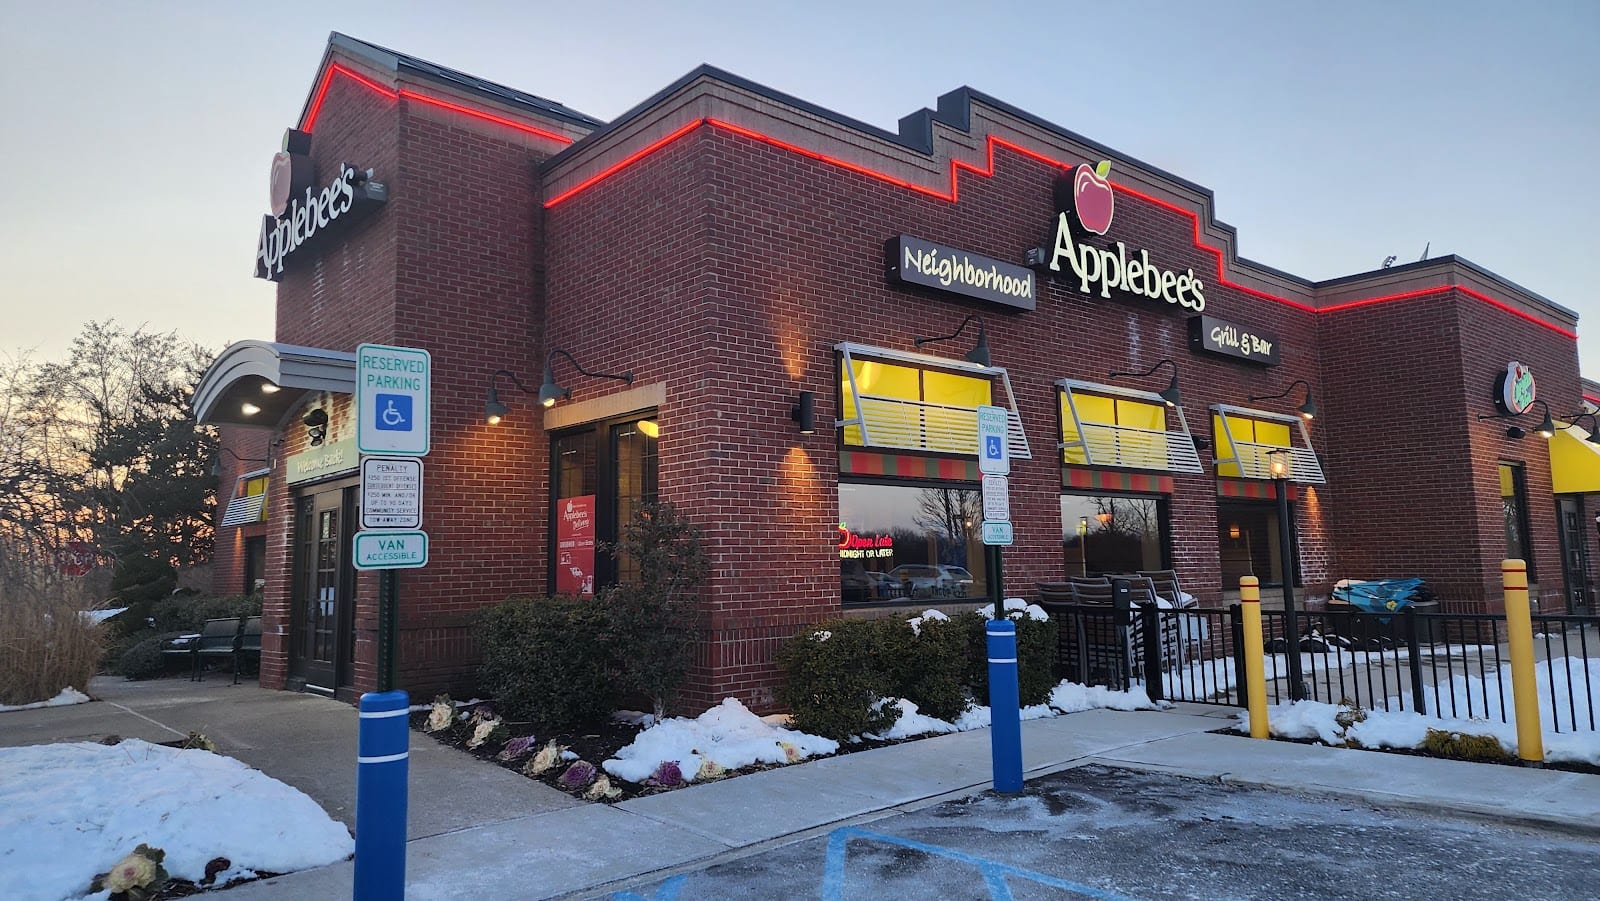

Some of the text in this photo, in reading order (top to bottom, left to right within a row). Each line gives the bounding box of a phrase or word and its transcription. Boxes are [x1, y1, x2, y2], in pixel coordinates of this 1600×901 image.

[253, 162, 354, 280] Applebee's
[1049, 211, 1206, 312] Applebee's
[904, 245, 1033, 300] Neighborhood
[1210, 324, 1273, 356] Grill & Bar
[363, 356, 424, 373] RESERVED
[367, 374, 421, 391] PARKING
[376, 464, 408, 473] PENALTY
[378, 540, 405, 551] VAN
[852, 534, 873, 549] Open
[366, 552, 417, 561] ACCESSIBLE
[866, 550, 875, 558] OR
[875, 549, 893, 558] LATER
